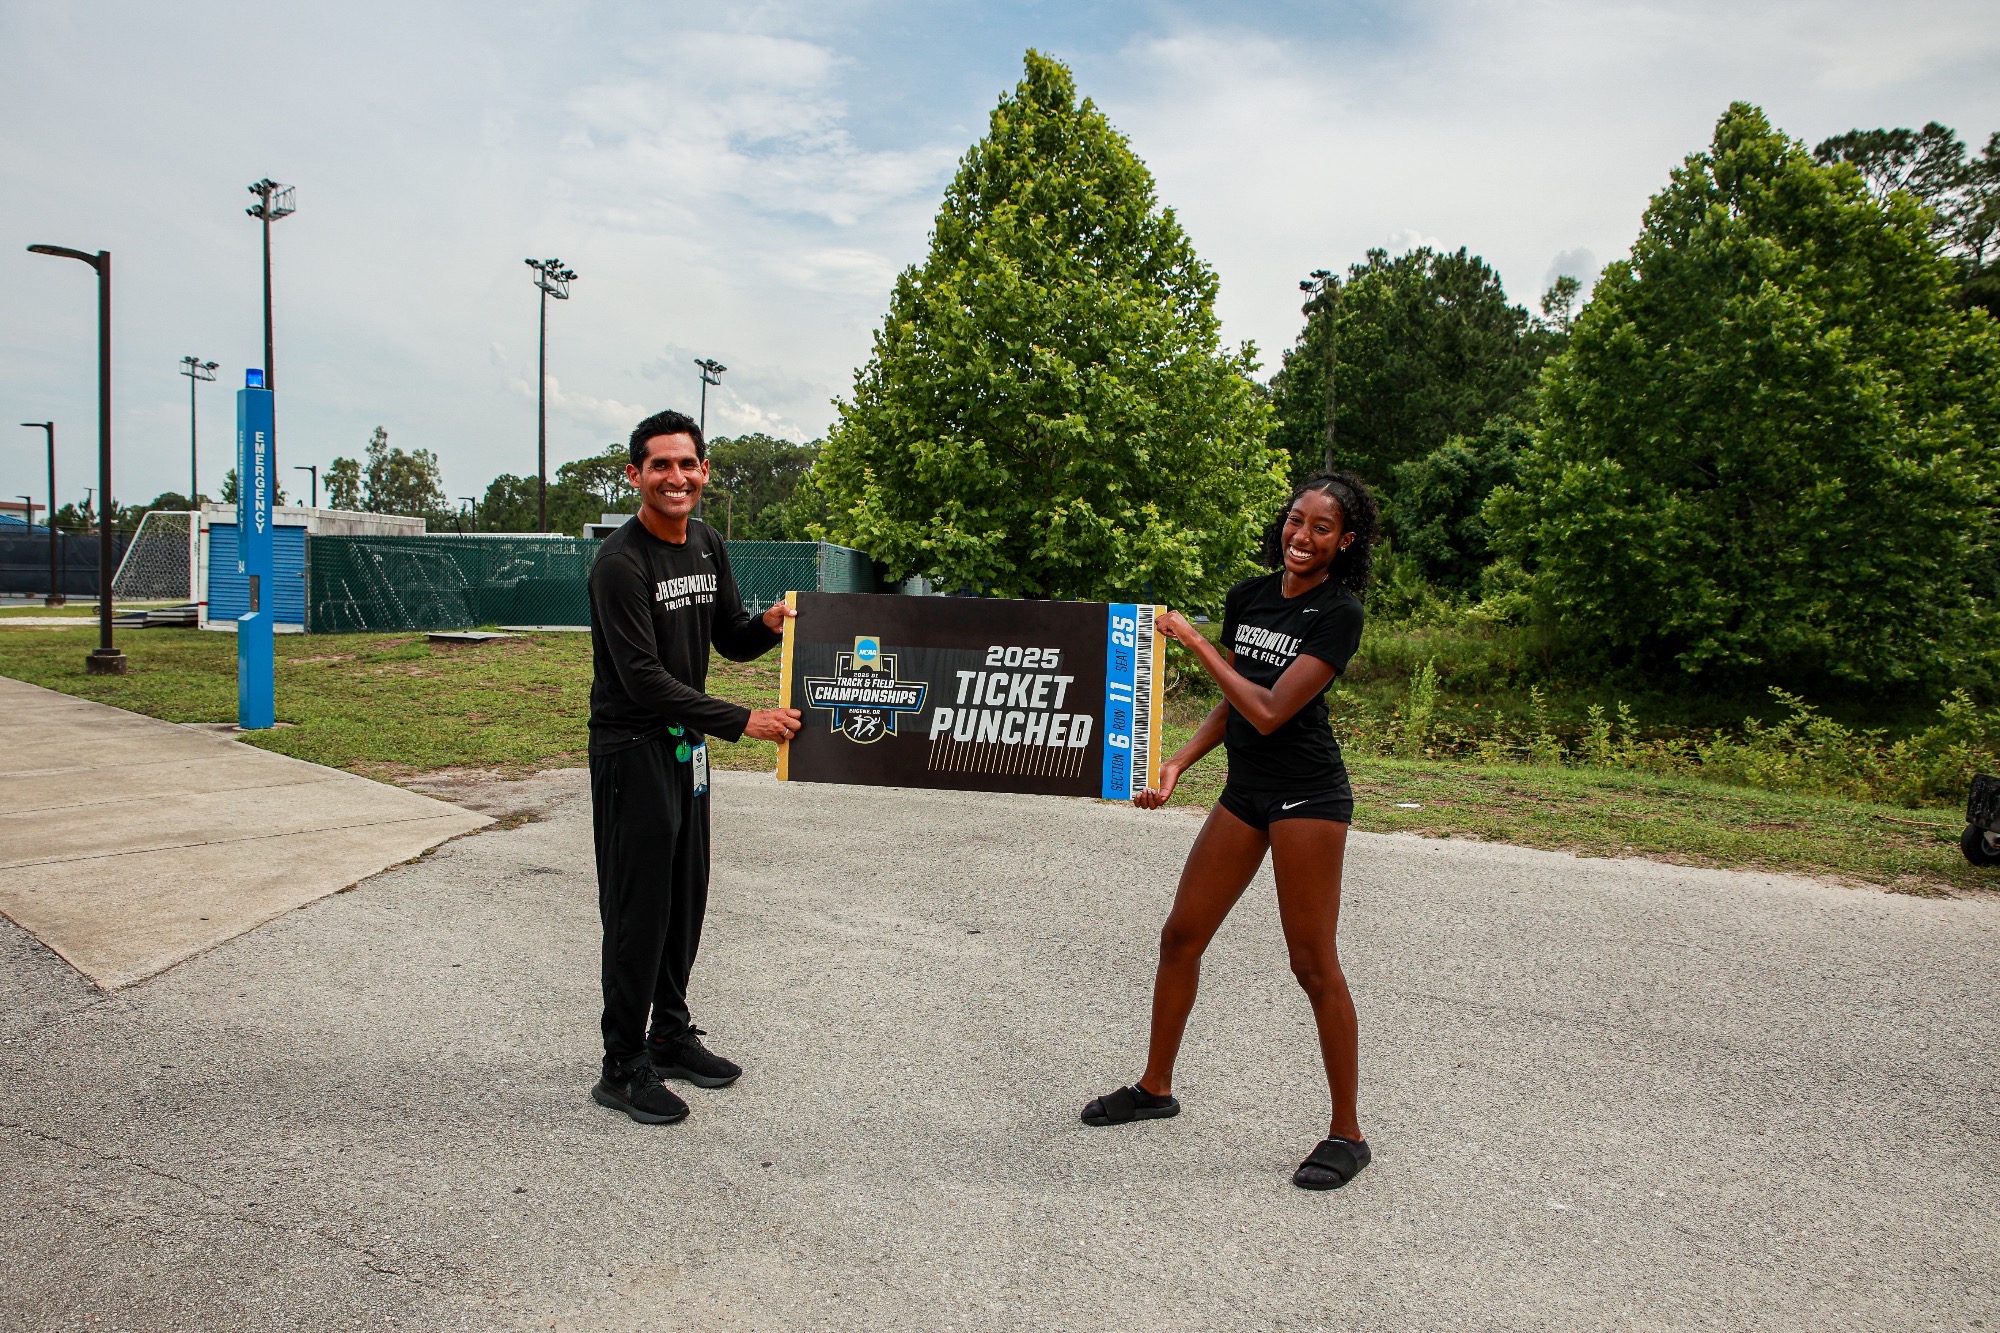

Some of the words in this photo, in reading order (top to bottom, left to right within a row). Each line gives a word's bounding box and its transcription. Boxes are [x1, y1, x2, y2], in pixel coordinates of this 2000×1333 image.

[254, 431, 266, 534] EMERGENCY
[685, 596, 692, 606] &
[1111, 615, 1135, 648] 25
[985, 645, 1061, 669] 2025
[1115, 649, 1128, 672] SEAT
[1251, 649, 1259, 660] &
[1260, 651, 1287, 667] FIELD
[837, 677, 864, 687] TRACK
[864, 679, 871, 688] &
[871, 679, 895, 689] FIELD
[956, 670, 1075, 710] TICKET
[1109, 681, 1132, 703] 11
[814, 686, 917, 705] CHAMPIONSHIPS
[928, 706, 1094, 748] PUNCHED
[1112, 708, 1126, 731] ROW
[1108, 732, 1130, 749] 6
[1111, 753, 1125, 792] SECTION
